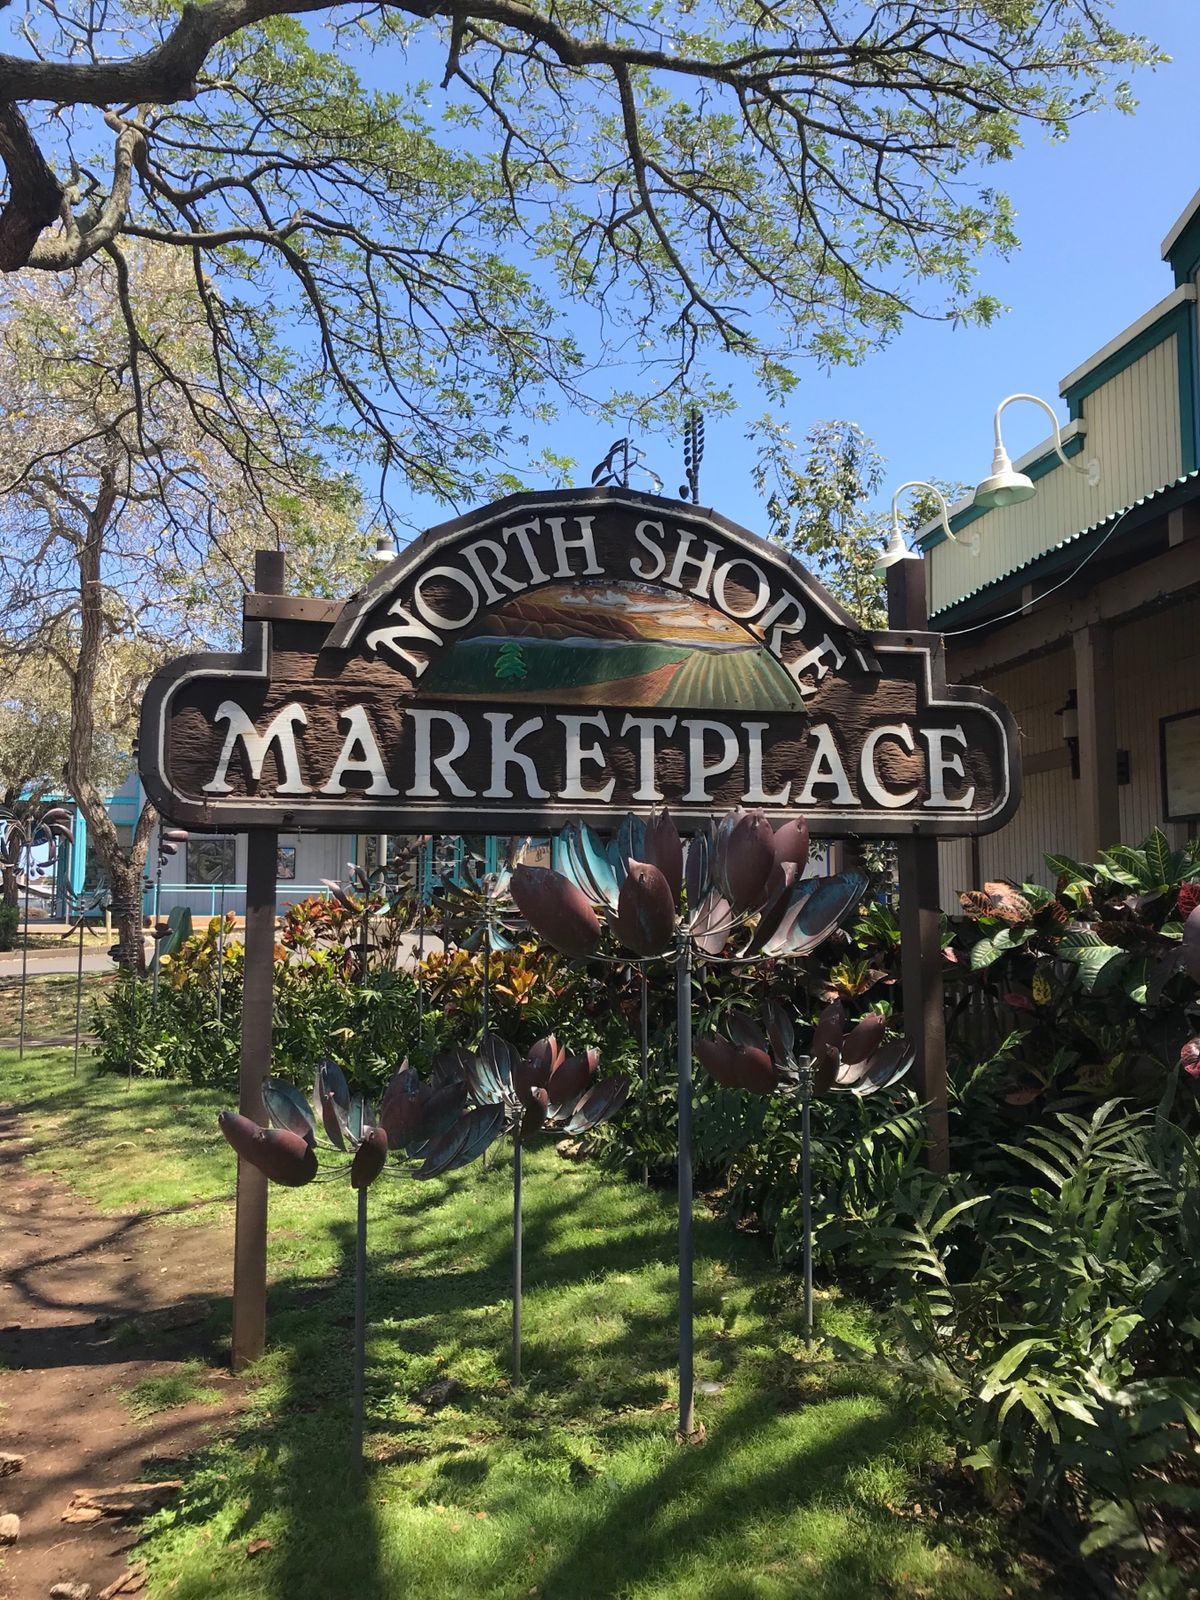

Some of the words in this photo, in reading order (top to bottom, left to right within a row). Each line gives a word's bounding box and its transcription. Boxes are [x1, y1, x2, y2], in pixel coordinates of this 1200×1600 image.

[366, 515, 605, 678] NORTH
[629, 520, 847, 696] SHORE
[202, 700, 977, 810] MARKETPLACE
